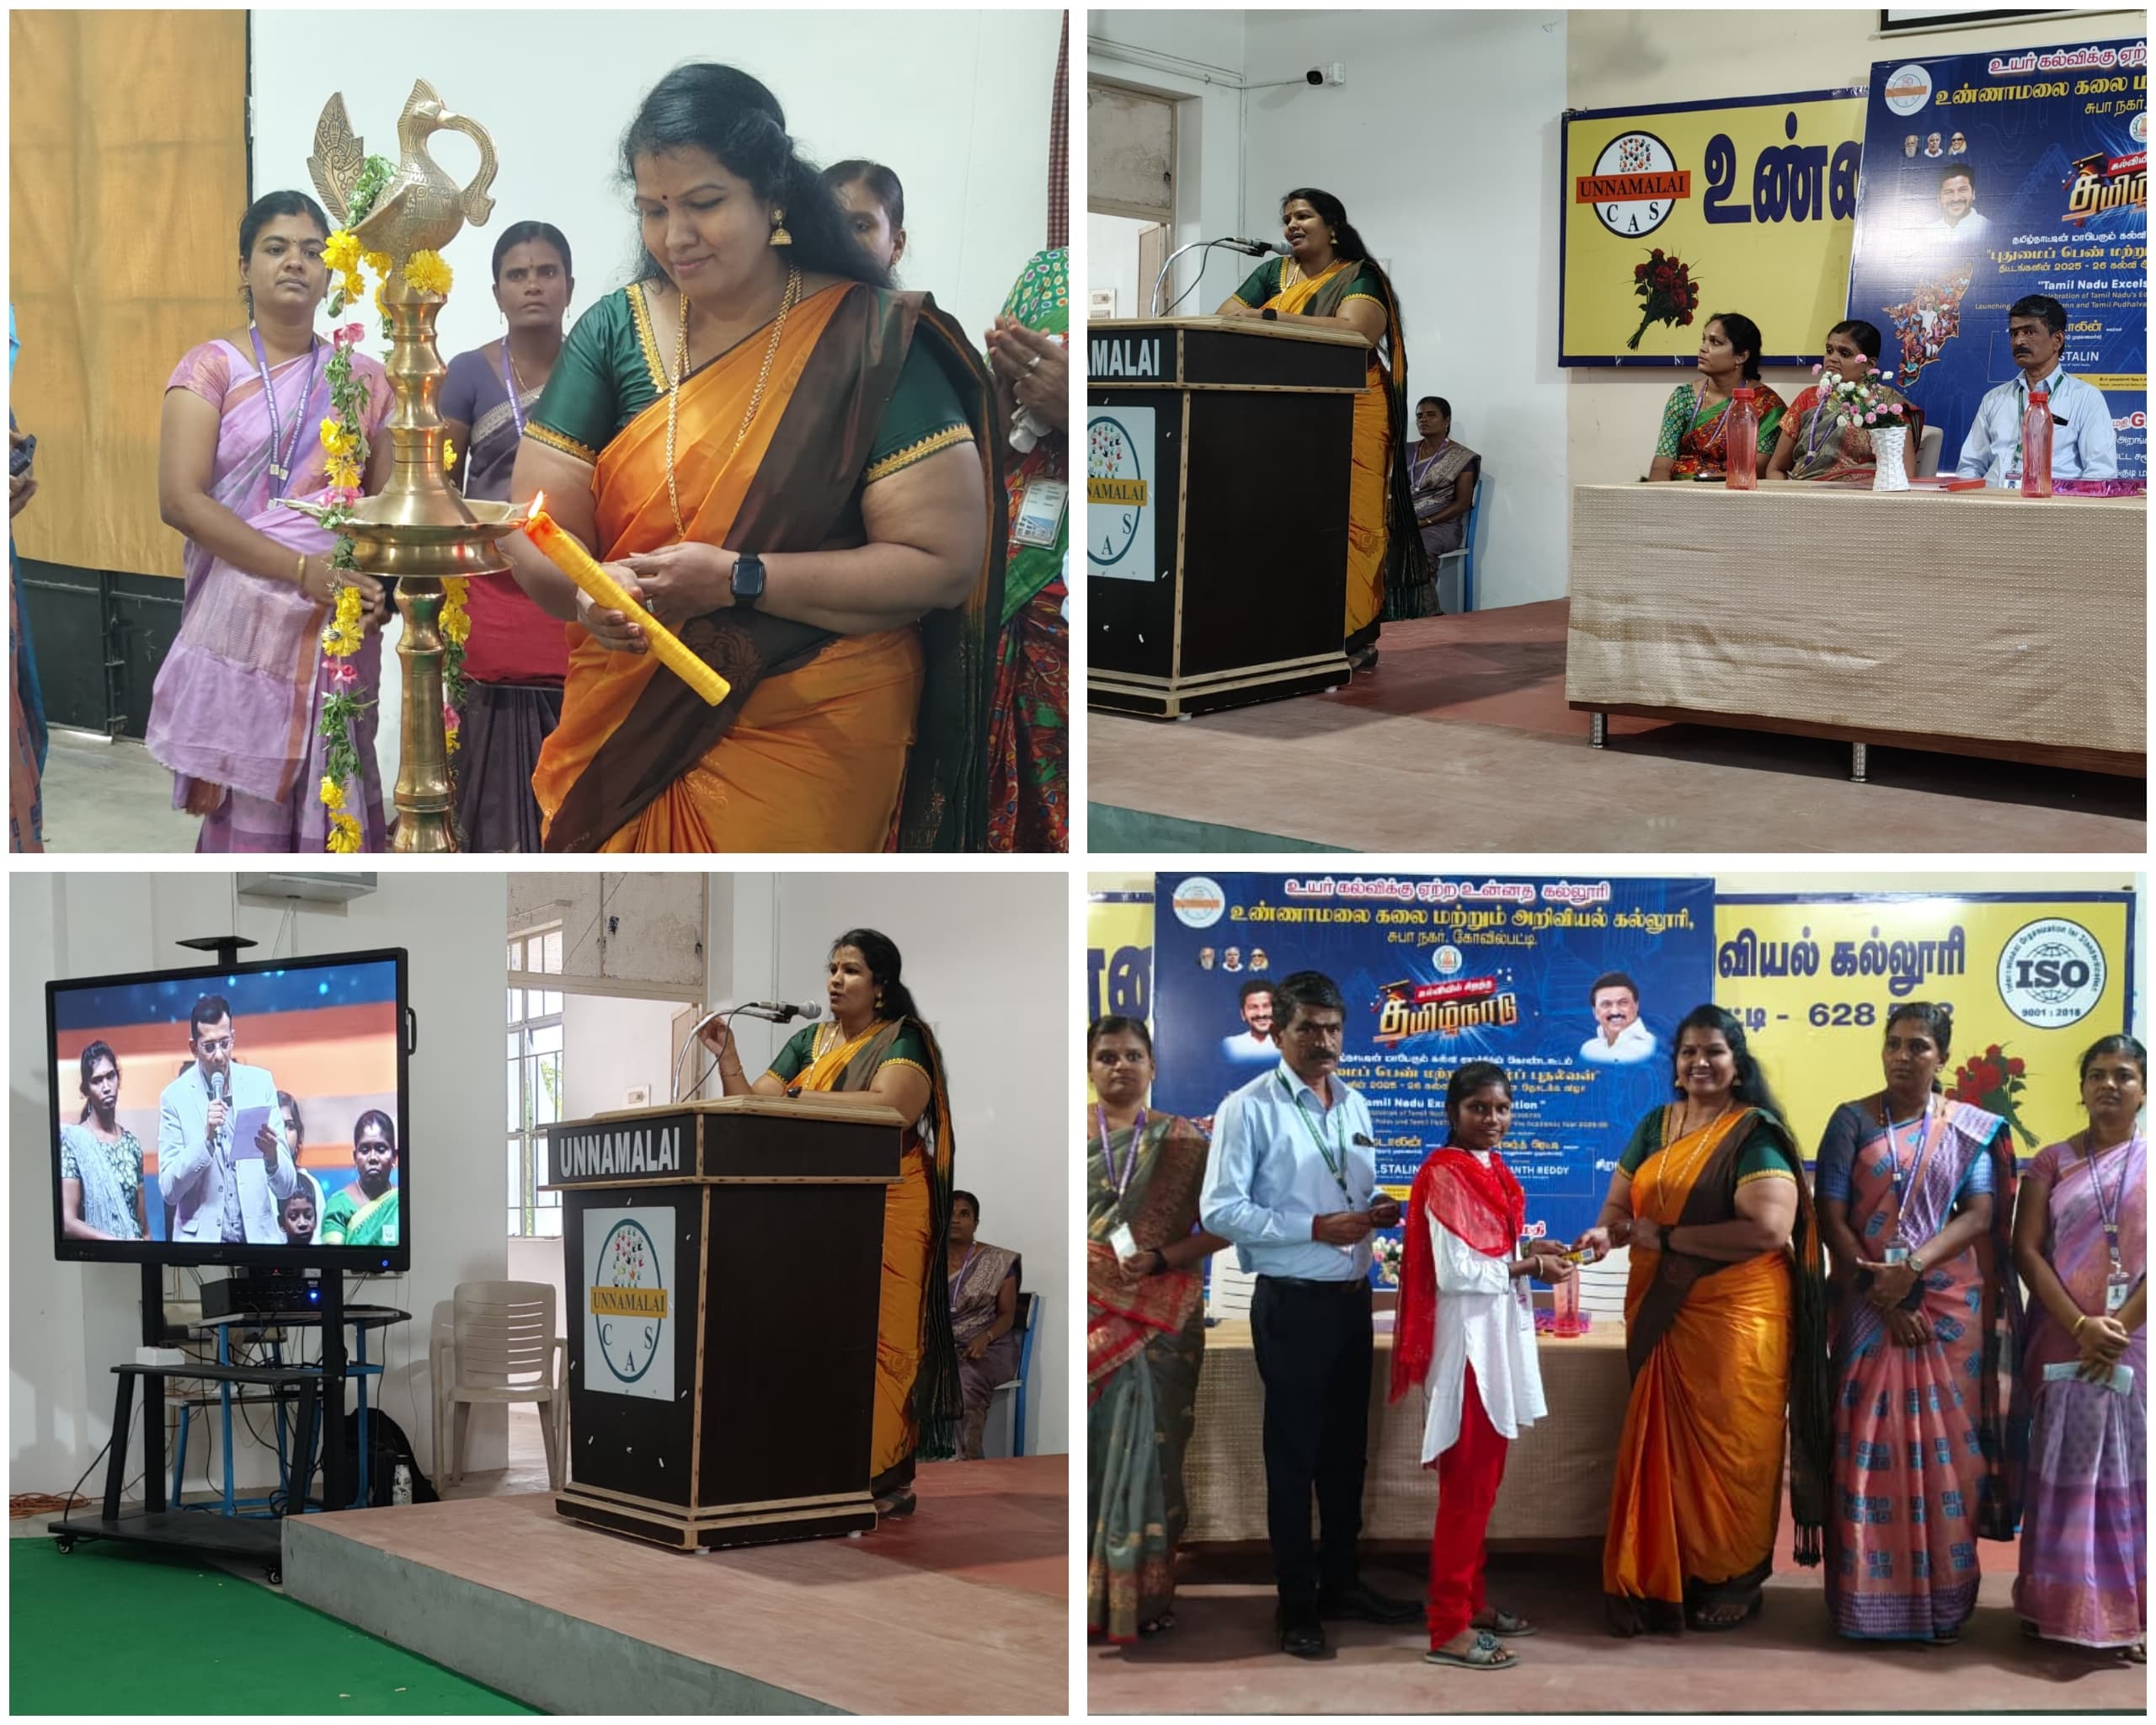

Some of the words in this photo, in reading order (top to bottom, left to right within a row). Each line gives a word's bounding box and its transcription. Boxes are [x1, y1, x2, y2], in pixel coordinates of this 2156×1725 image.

[1989, 54, 2037, 73] உயர்
[2039, 45, 2117, 69] கல்விக்கு
[2118, 41, 2147, 67] ஏற்
[1935, 82, 2069, 107] உண்ணாமலை
[2074, 77, 2128, 95] கலை
[1580, 175, 1685, 198] UNNAMALAI
[1607, 204, 1619, 222] C
[1627, 214, 1641, 232] A
[1648, 202, 1659, 221] S
[2072, 231, 2116, 243] மாபெரும்
[2061, 245, 2105, 258] பெண்
[2054, 262, 2082, 270] 2025
[2092, 261, 2107, 270] 26
[2077, 280, 2108, 289] Nadu
[1087, 339, 1160, 377] MALAI
[1102, 534, 1113, 555] A
[1123, 513, 1132, 535] S
[1286, 878, 1334, 895] உயர்
[1337, 879, 1414, 898] கல்விக்கு
[1542, 882, 1611, 905] கல்லூரி
[1230, 901, 1369, 924] உண்ணாமலை
[1376, 908, 1428, 924] கலை
[1433, 905, 1507, 929] மற்றும்
[1512, 906, 1608, 930] அறிவியல்
[1716, 926, 1820, 978] வியல்
[1831, 924, 1965, 997] கல்லூரி
[2015, 959, 2090, 989] ISO
[1809, 1002, 1875, 1027] 628
[2022, 1008, 2047, 1017] 9001
[1366, 1097, 1391, 1108] amil
[1395, 1097, 1424, 1108] Nadu
[560, 1127, 680, 1178] UNNAMALAI
[1537, 1166, 1569, 1175] REDDY
[593, 1291, 665, 1313] UNNAMALAI
[602, 1323, 613, 1346] C
[624, 1350, 637, 1372] A
[643, 1326, 654, 1349] S
